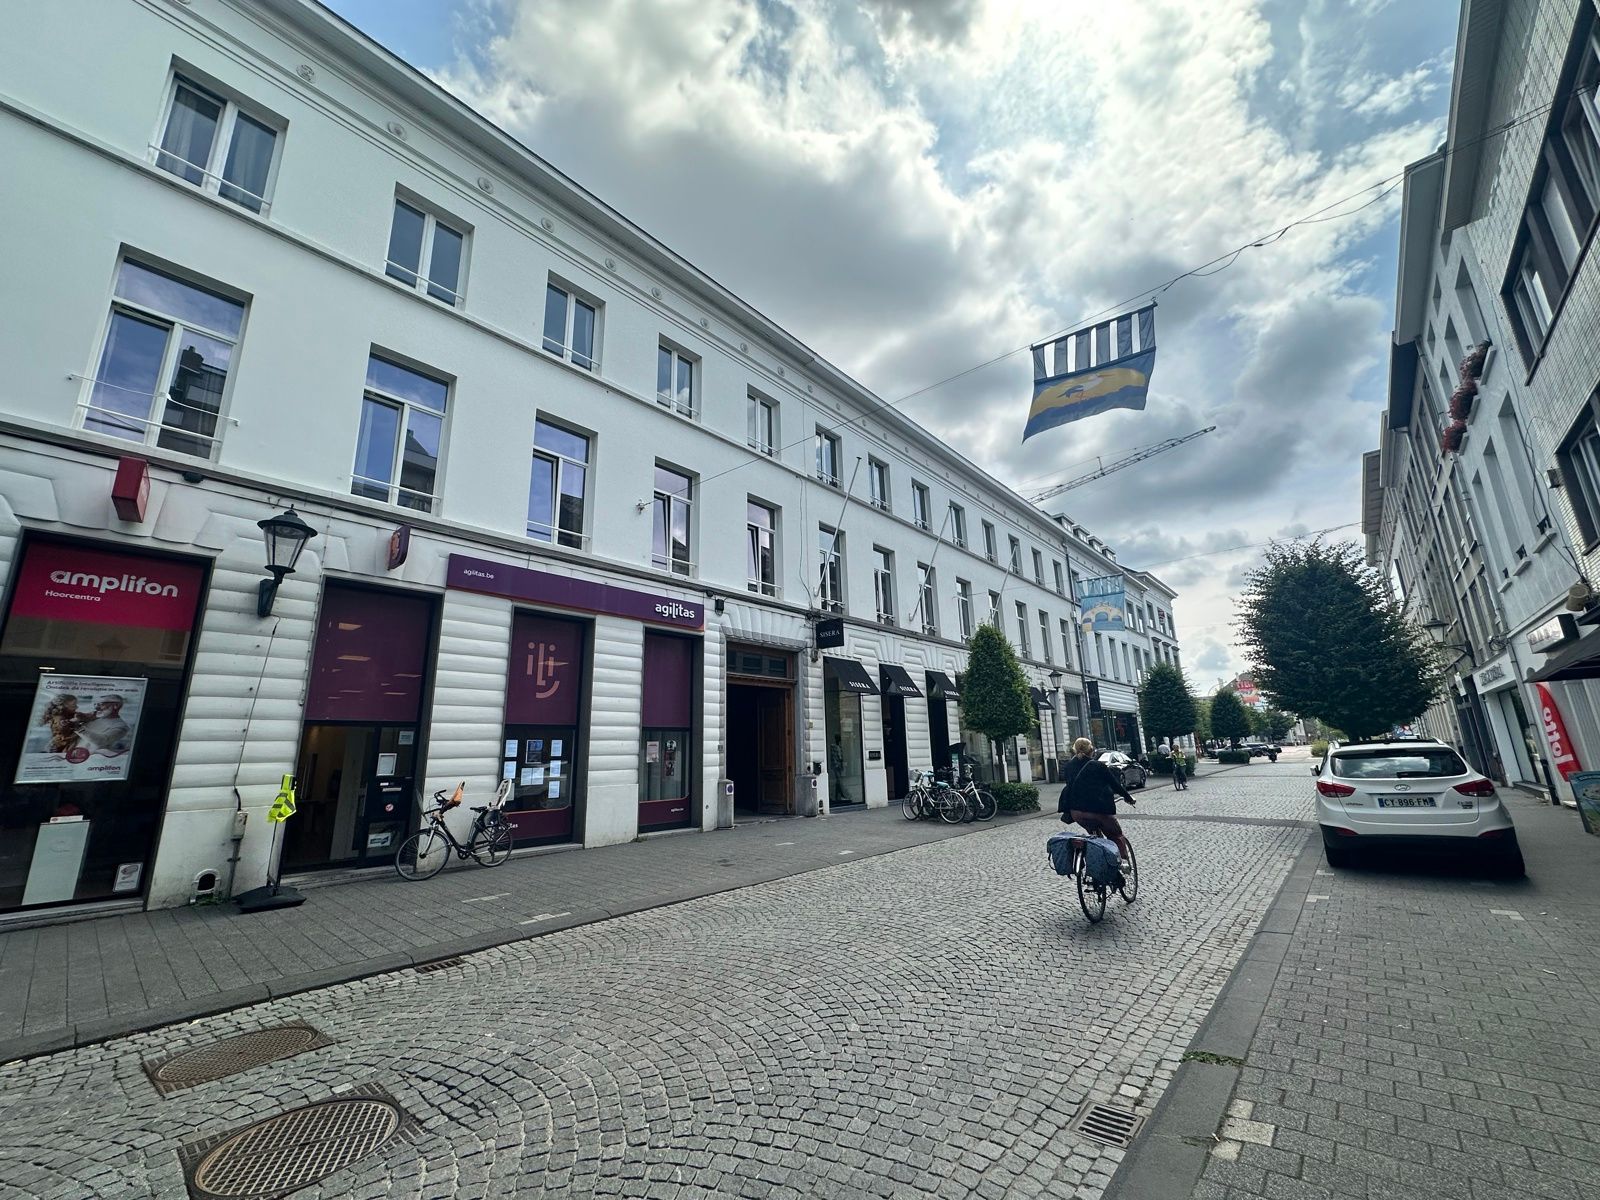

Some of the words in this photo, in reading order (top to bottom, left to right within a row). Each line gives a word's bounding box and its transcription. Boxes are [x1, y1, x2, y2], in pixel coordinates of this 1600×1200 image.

[463, 569, 495, 580] agilitas.be
[50, 570, 179, 598] amplifon
[45, 589, 102, 602] Hoorcentra
[655, 602, 696, 619] agilitas
[819, 630, 841, 638] SISERA
